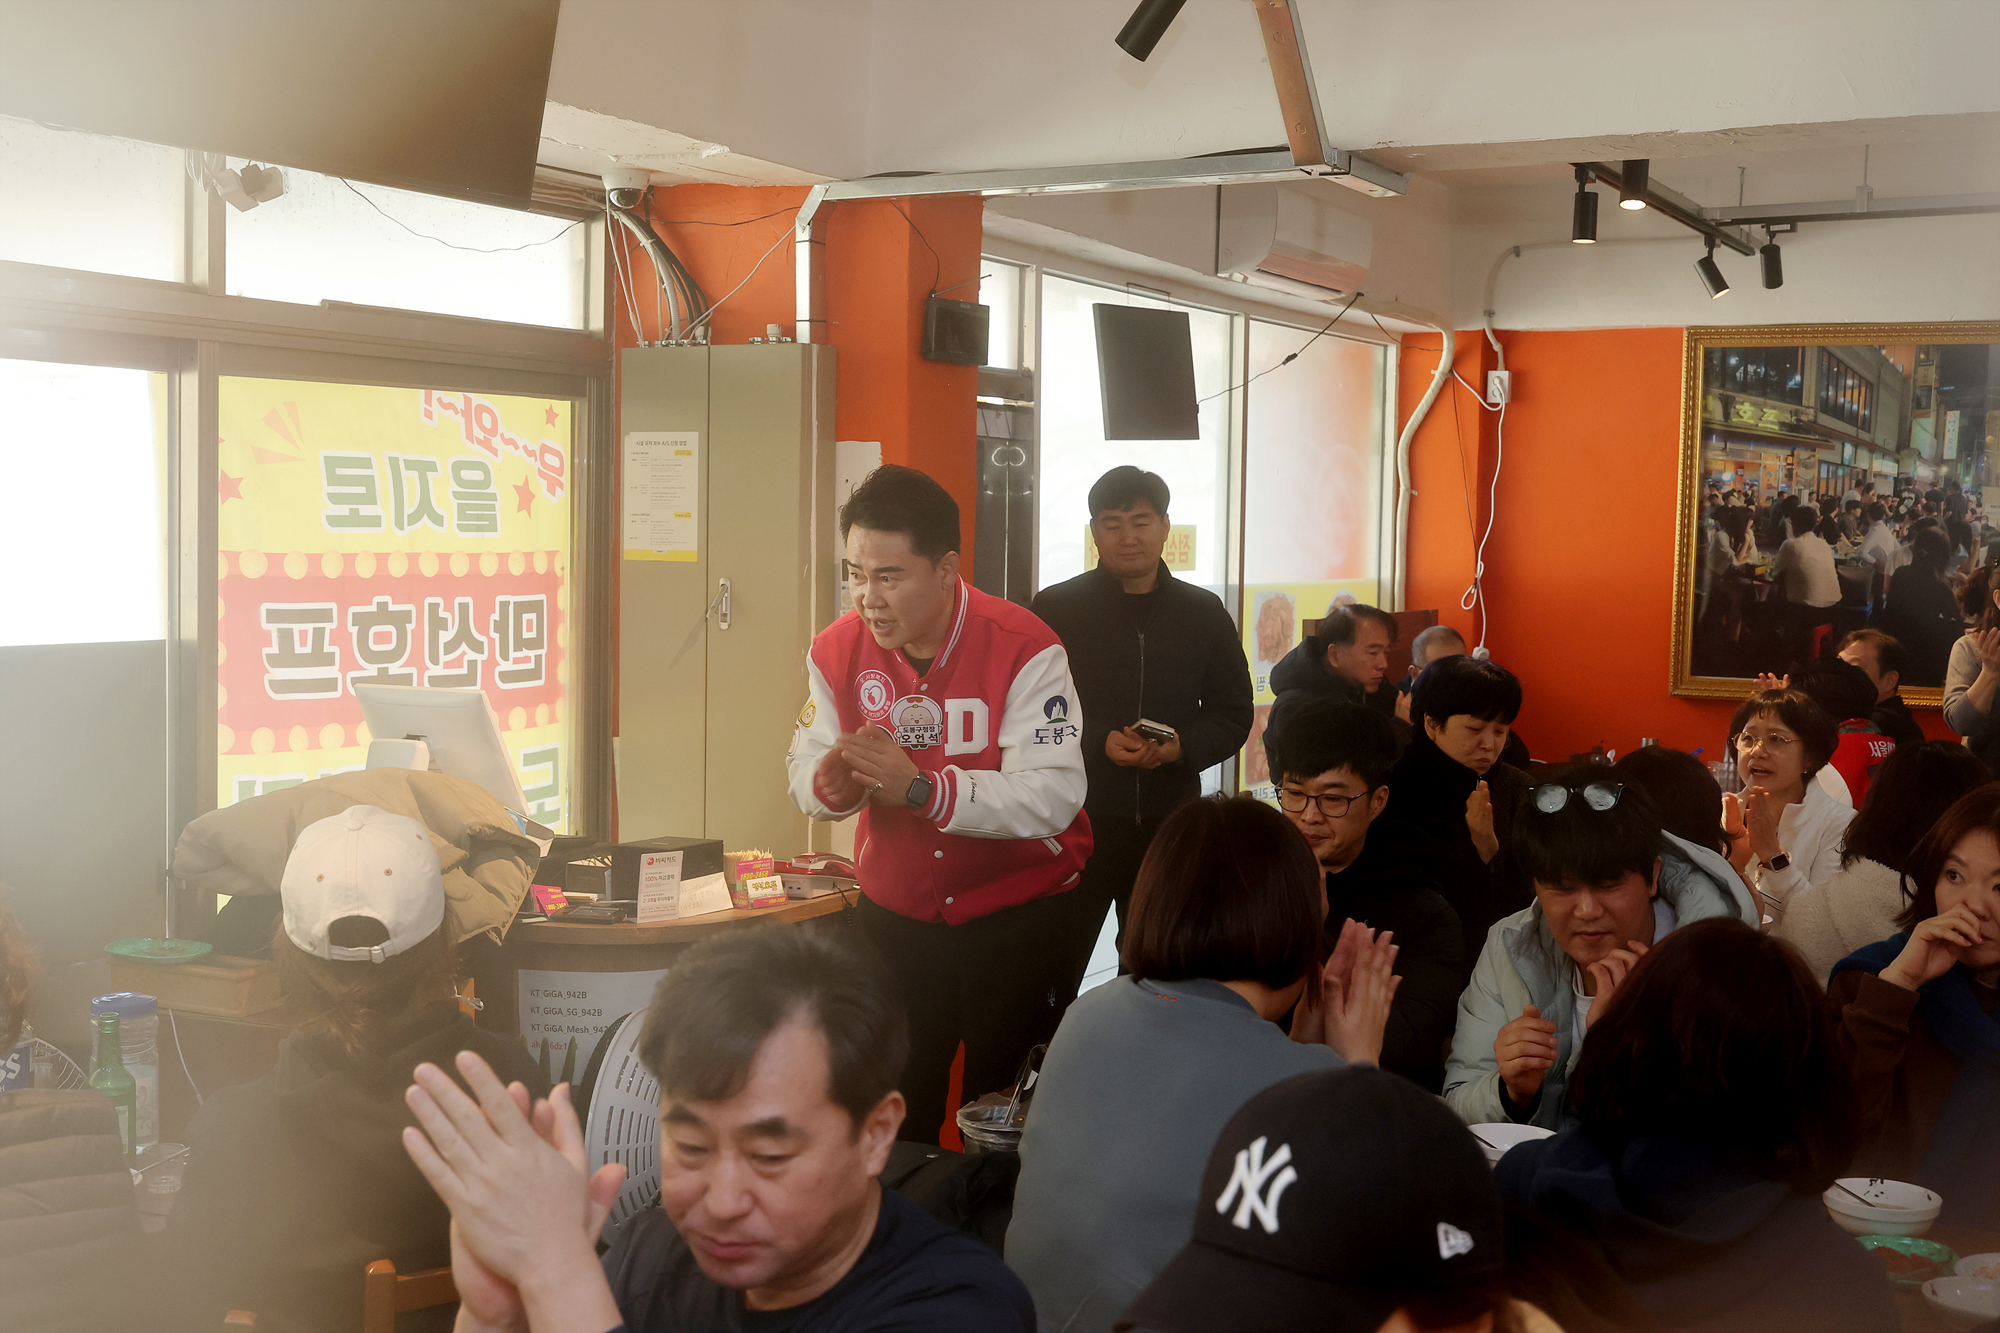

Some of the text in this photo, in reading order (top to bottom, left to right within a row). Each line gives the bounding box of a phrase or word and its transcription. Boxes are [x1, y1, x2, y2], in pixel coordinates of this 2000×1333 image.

[945, 698, 989, 756] D
[655, 856, 677, 864] 비씨카드
[530, 989, 588, 999] KT_GiGA_942B
[530, 1006, 603, 1018] KT_GiGA_5G_942B
[1215, 1135, 1298, 1234] NY
